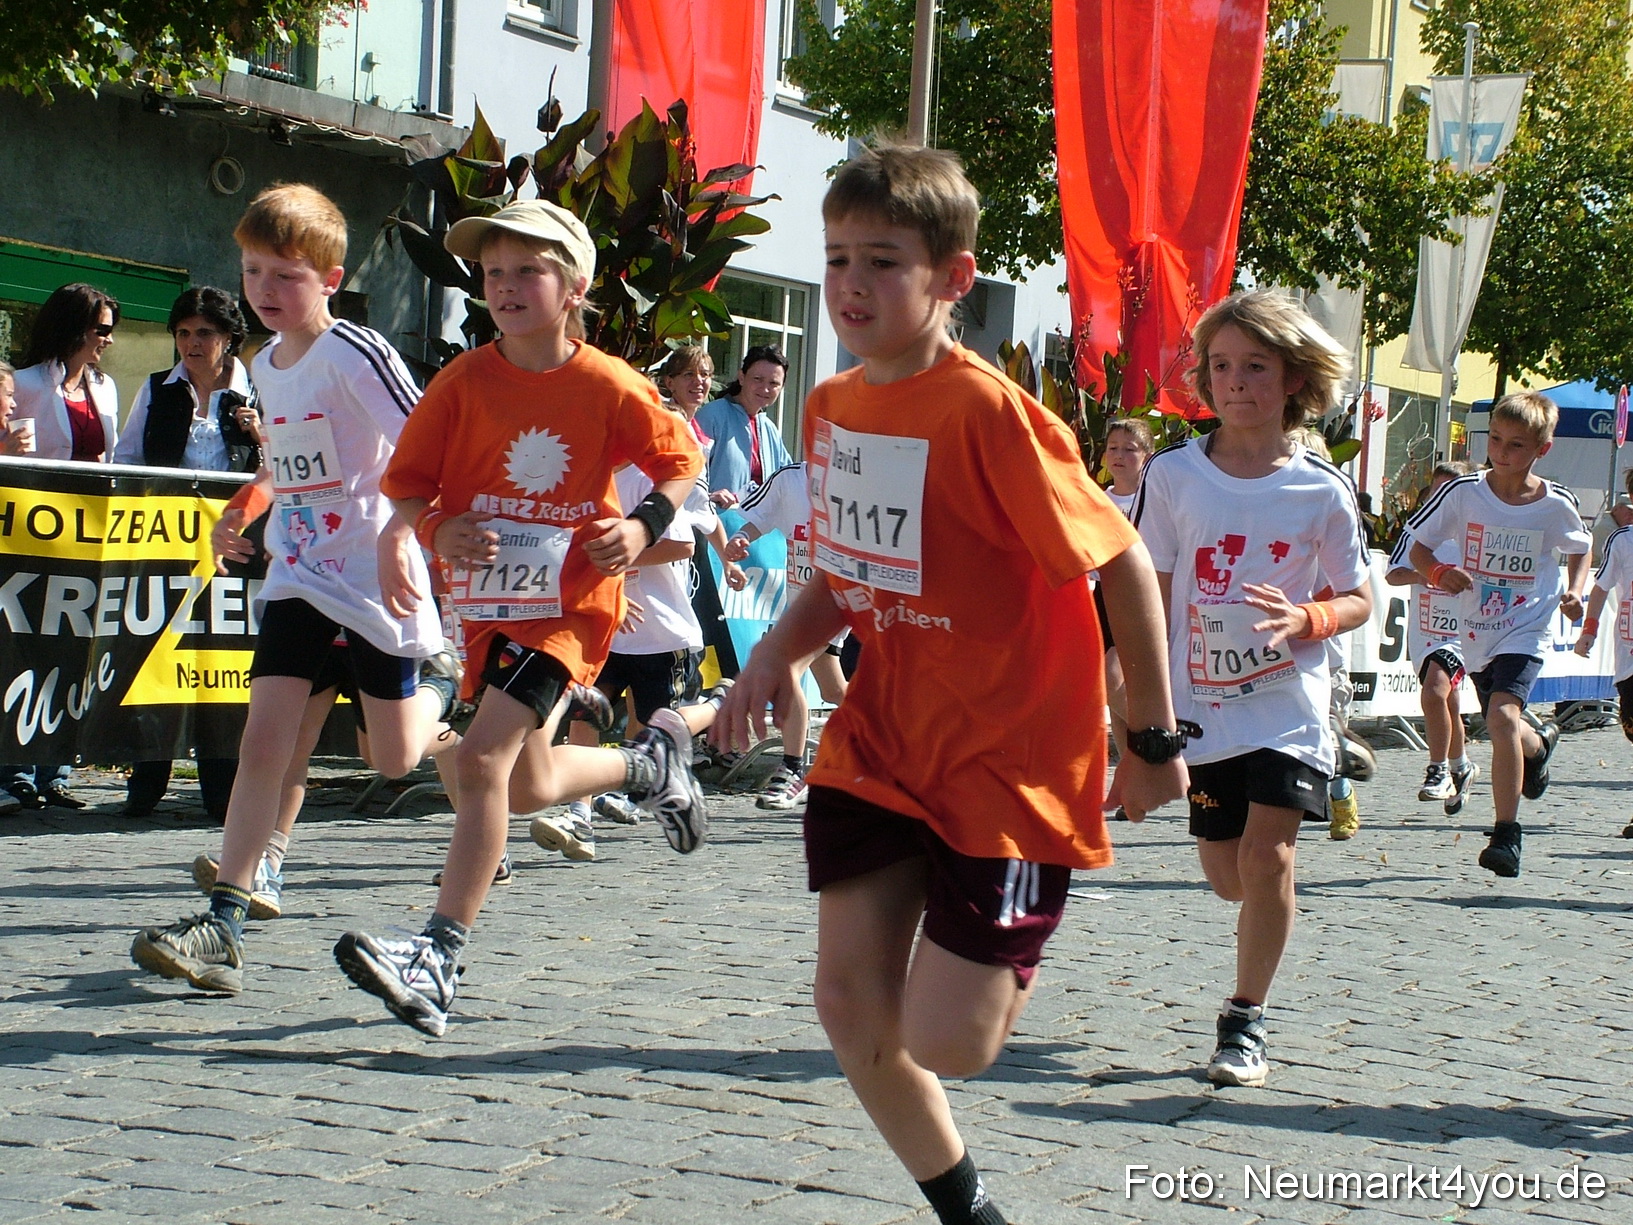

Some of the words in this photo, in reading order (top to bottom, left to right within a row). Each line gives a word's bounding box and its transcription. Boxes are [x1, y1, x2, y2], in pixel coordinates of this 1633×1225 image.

[273, 451, 327, 482] 7191
[831, 440, 862, 475] David
[470, 494, 535, 518] HERZ
[0, 501, 200, 545] HOLZBAU
[830, 495, 908, 548] 7117
[1484, 531, 1532, 553] DANIEL
[1485, 552, 1533, 573] 7180
[479, 563, 548, 591] 7124
[869, 563, 919, 584] PFLEIDERER
[511, 604, 560, 614] PFLEIDERER
[1432, 605, 1451, 615] Sven
[1201, 614, 1223, 633] Tim
[1432, 616, 1457, 631] 720
[1192, 641, 1202, 655] K4
[1210, 646, 1282, 675] 7015
[1253, 666, 1297, 686] PFLEIDERER
